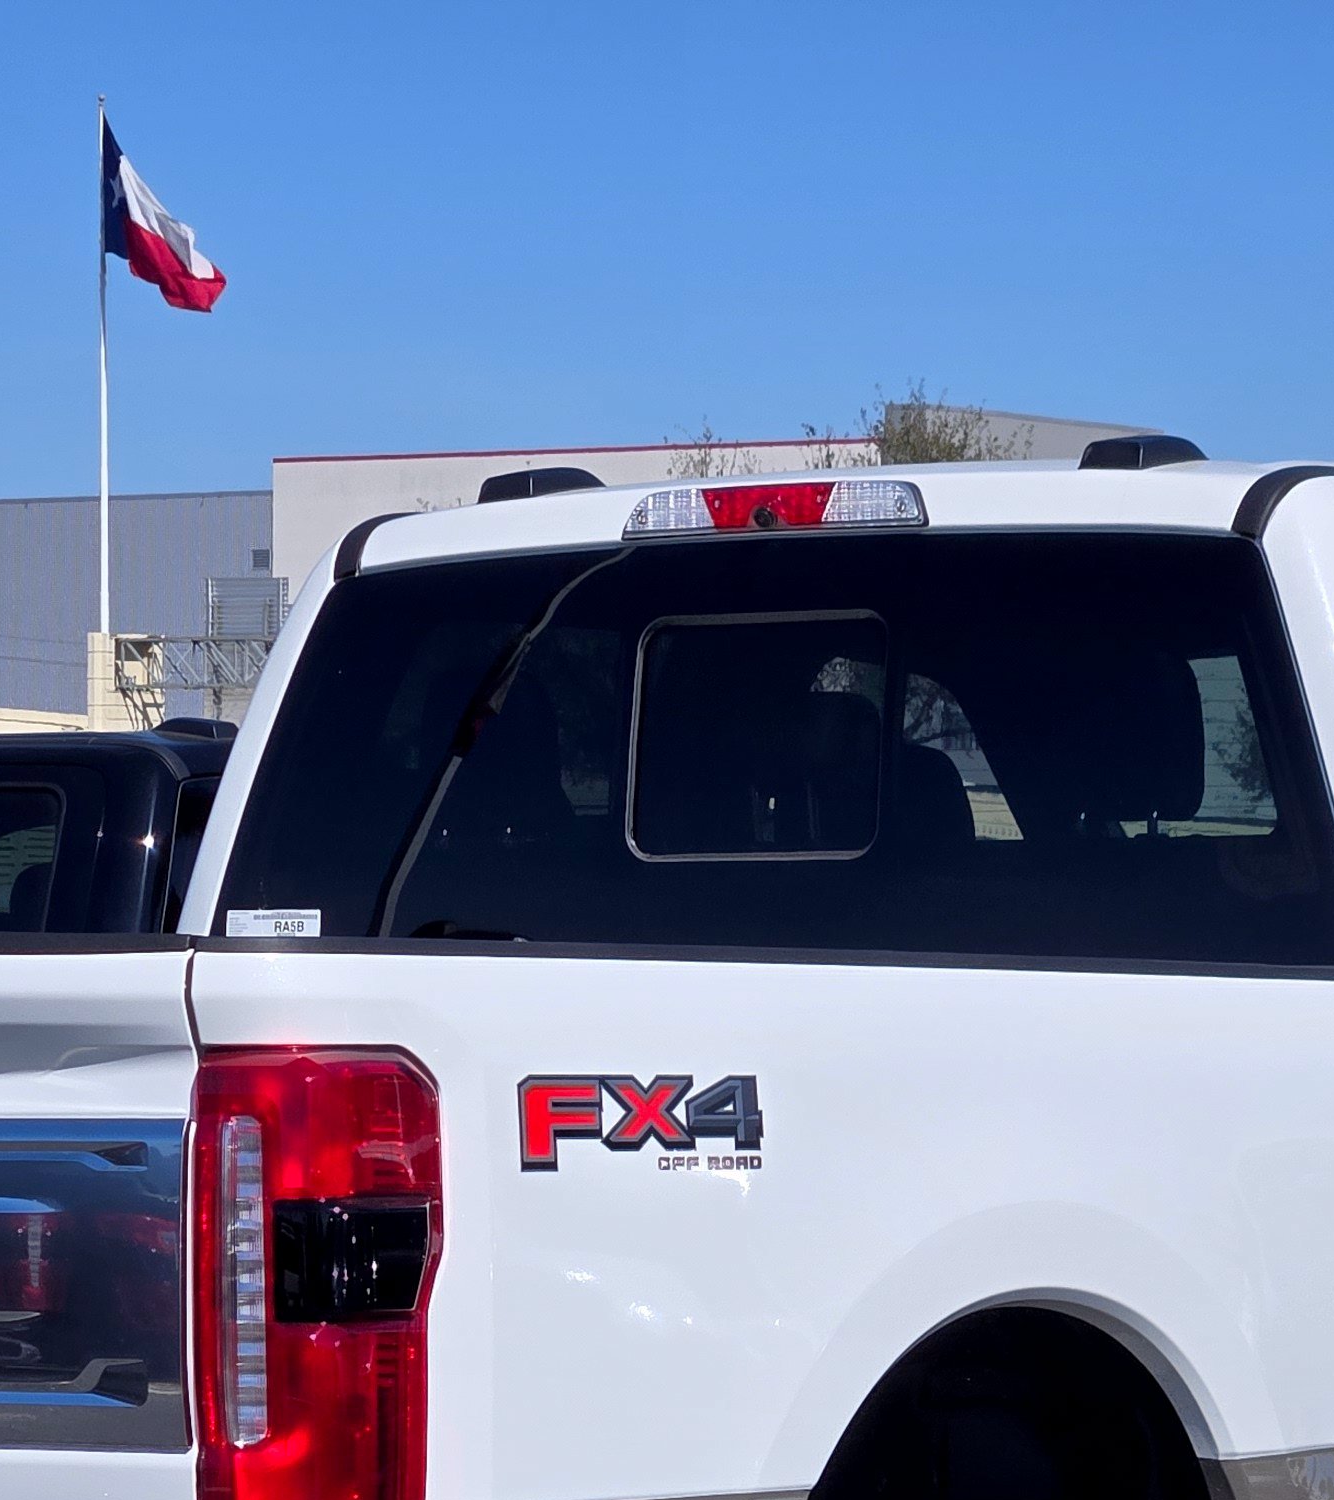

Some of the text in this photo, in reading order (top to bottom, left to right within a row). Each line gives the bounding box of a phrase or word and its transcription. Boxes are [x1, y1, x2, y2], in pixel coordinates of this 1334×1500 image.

[274, 920, 305, 933] RA5B
[517, 1074, 764, 1172] FX4
[658, 1156, 762, 1170] OFF ROAD
